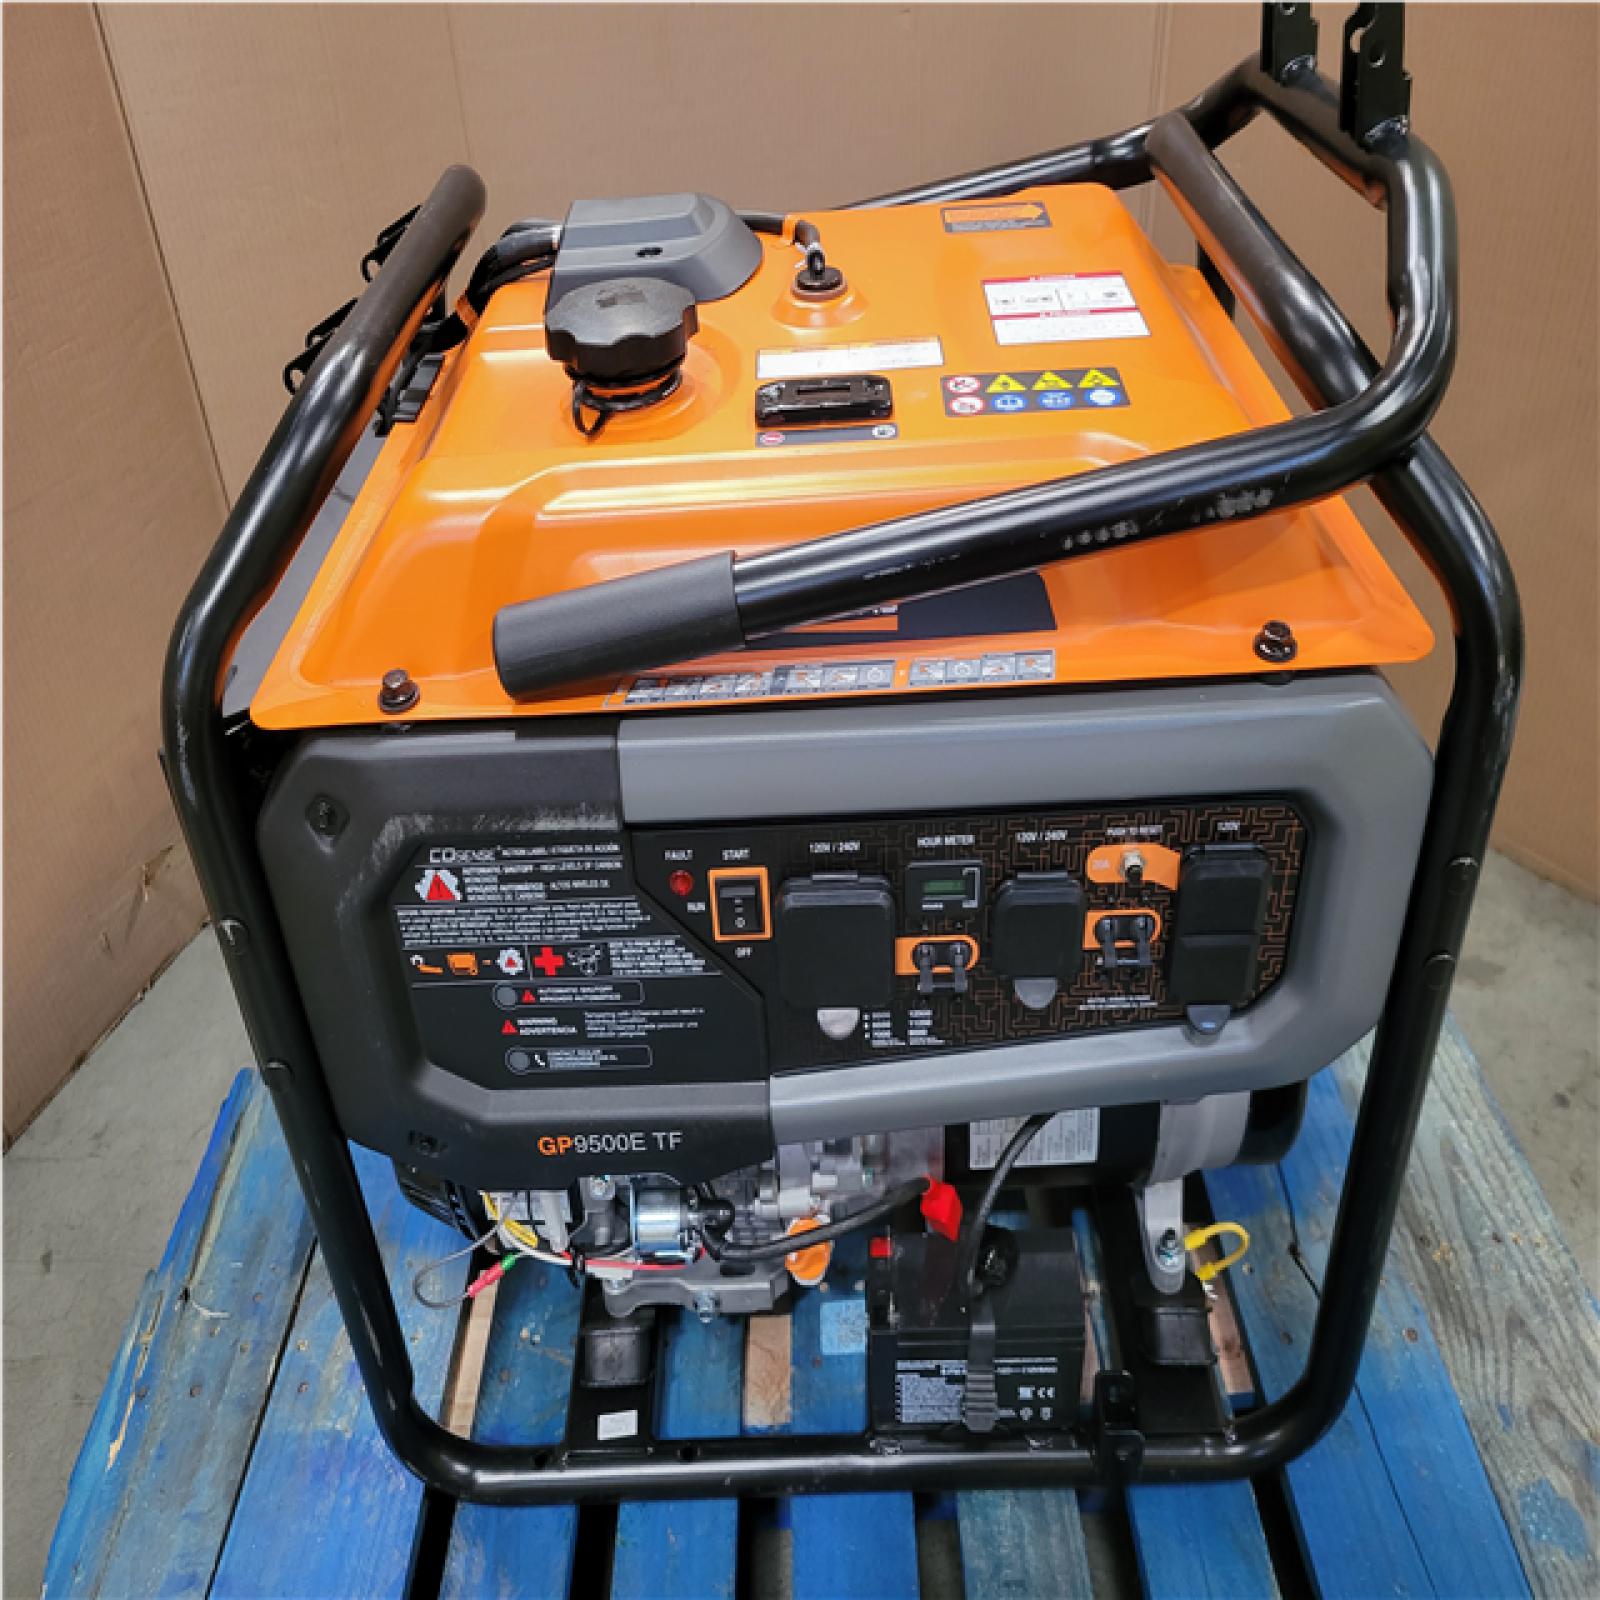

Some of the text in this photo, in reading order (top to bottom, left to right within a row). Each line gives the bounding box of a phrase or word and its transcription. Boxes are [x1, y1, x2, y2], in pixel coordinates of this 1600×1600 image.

[917, 834, 975, 848] HOUR METER
[664, 849, 693, 860] FAULT
[722, 848, 749, 860] START
[735, 947, 752, 958] OFF
[538, 1131, 683, 1156] GP9500E TF
